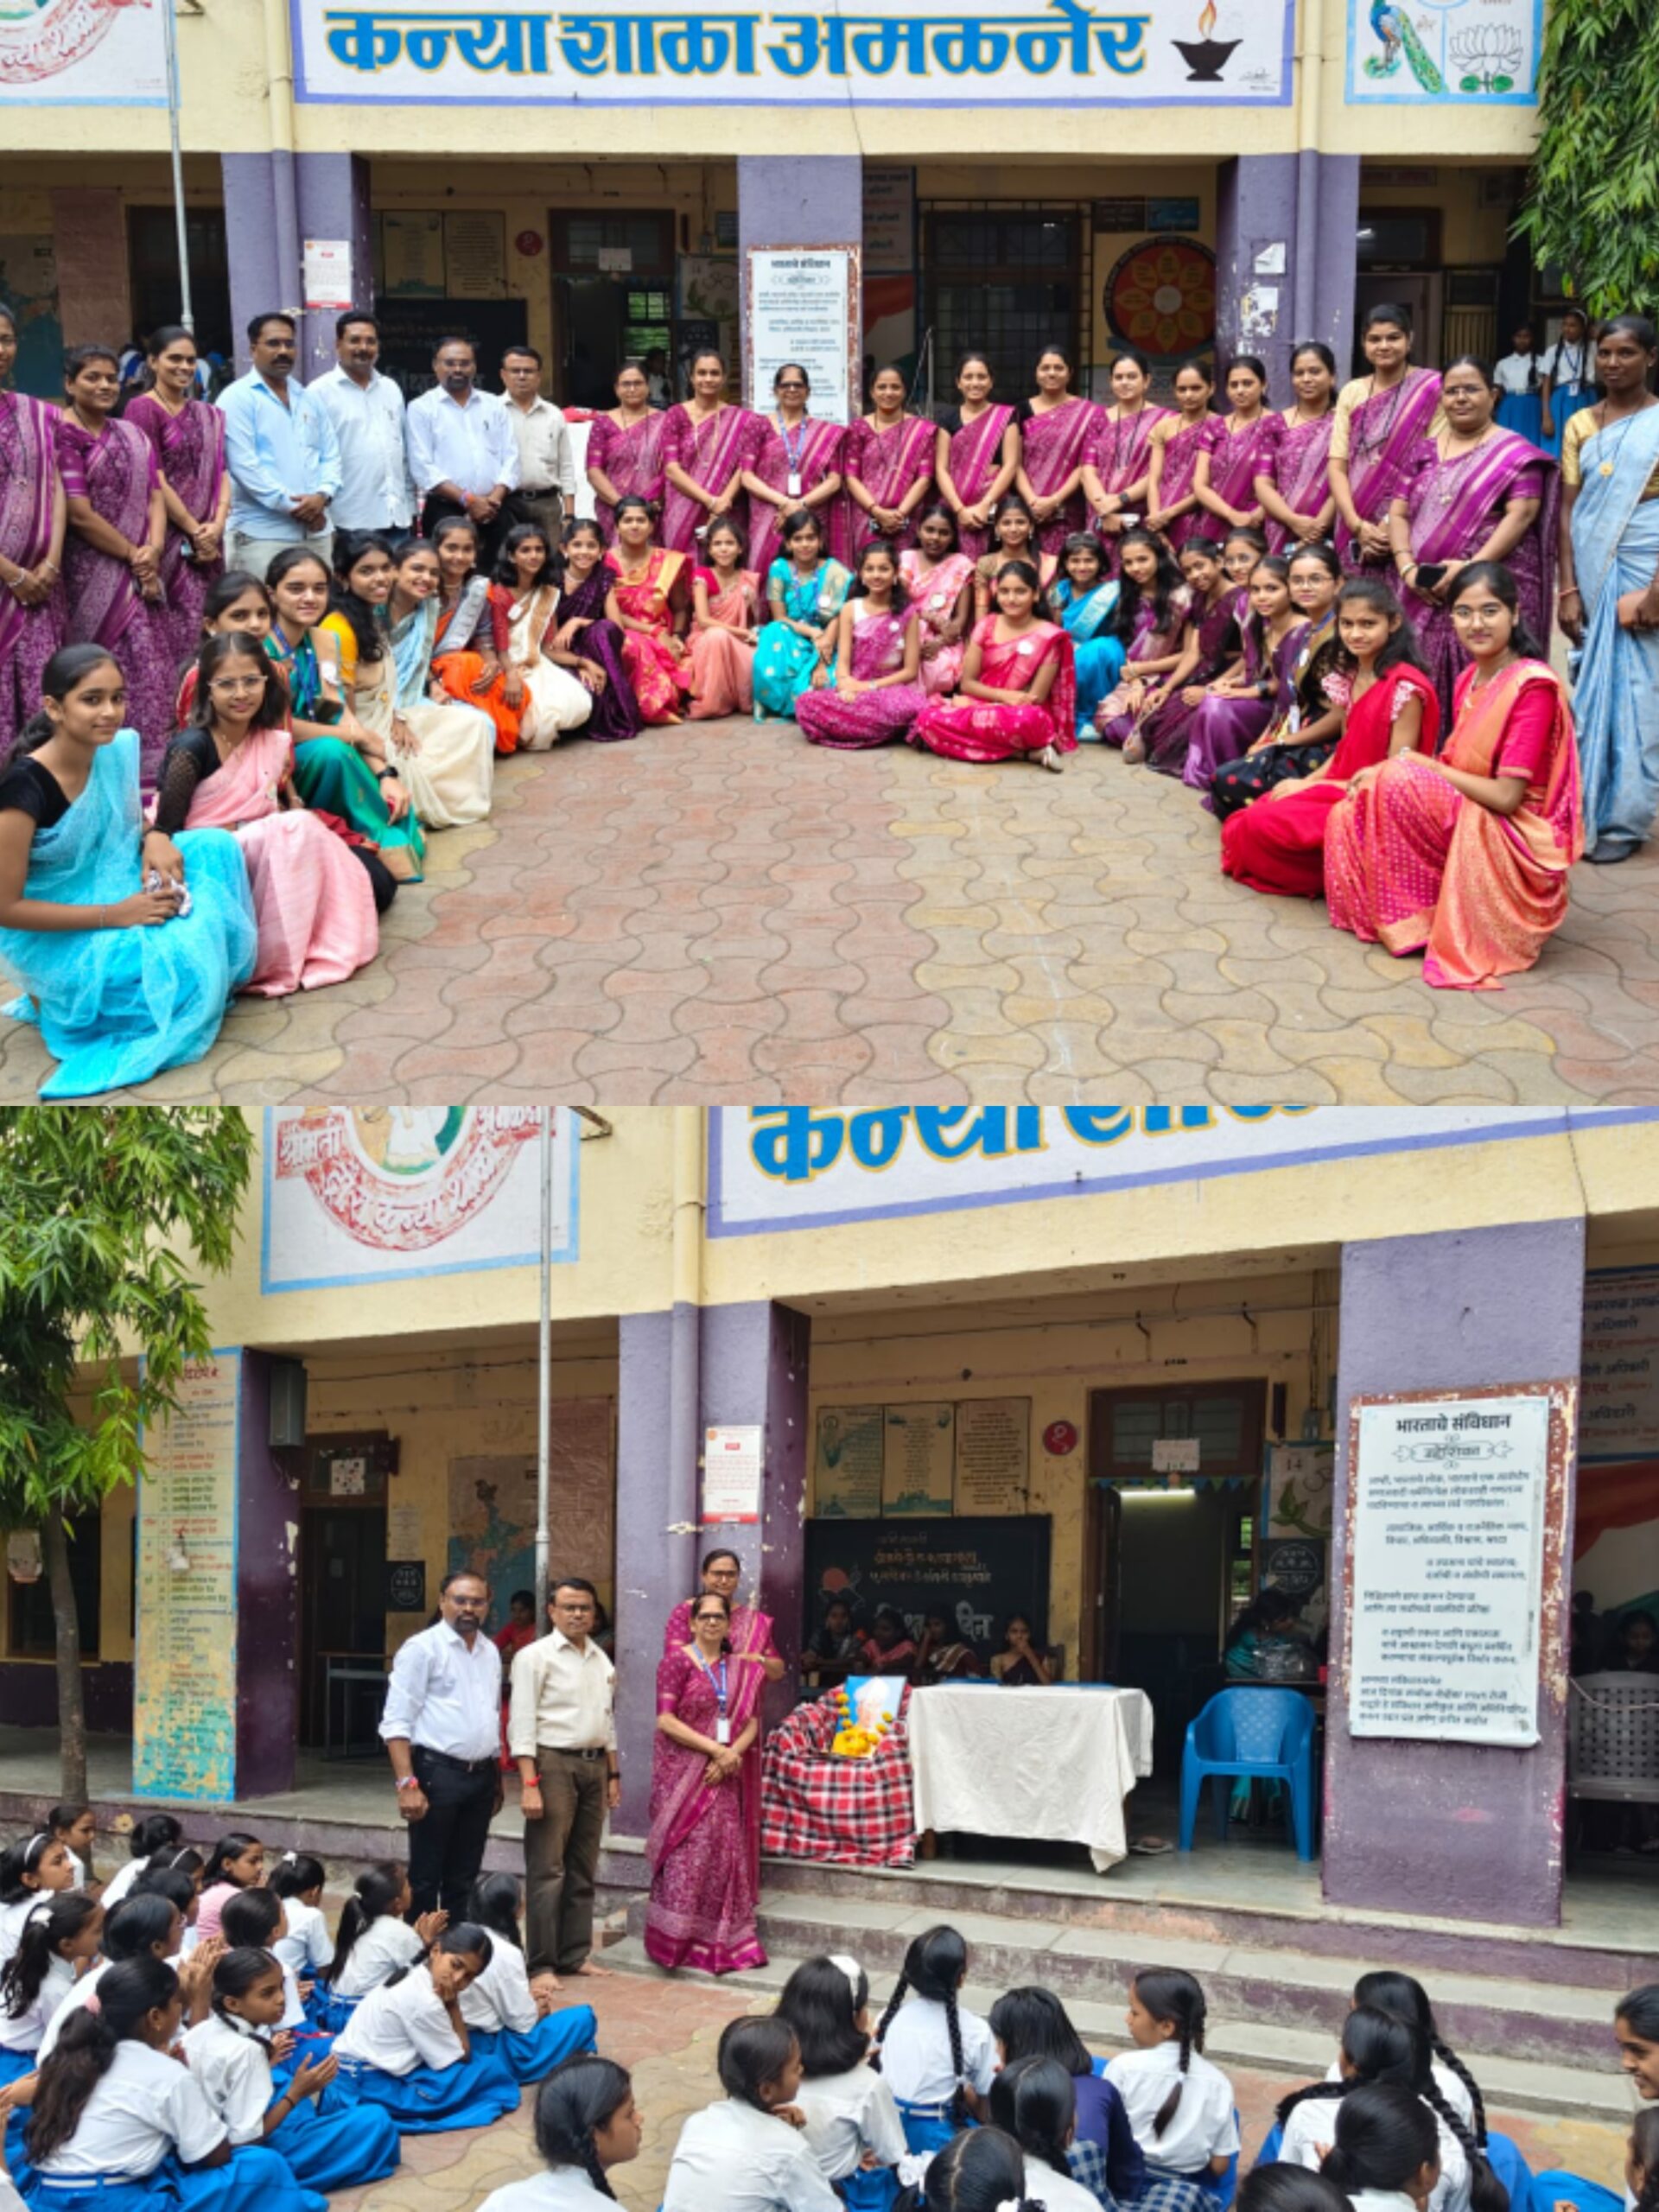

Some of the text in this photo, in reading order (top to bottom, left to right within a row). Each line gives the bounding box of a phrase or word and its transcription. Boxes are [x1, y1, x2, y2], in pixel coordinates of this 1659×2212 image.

[324, 10, 552, 74] कन्या
[1395, 1410, 1511, 1433] भारताचे संविधान
